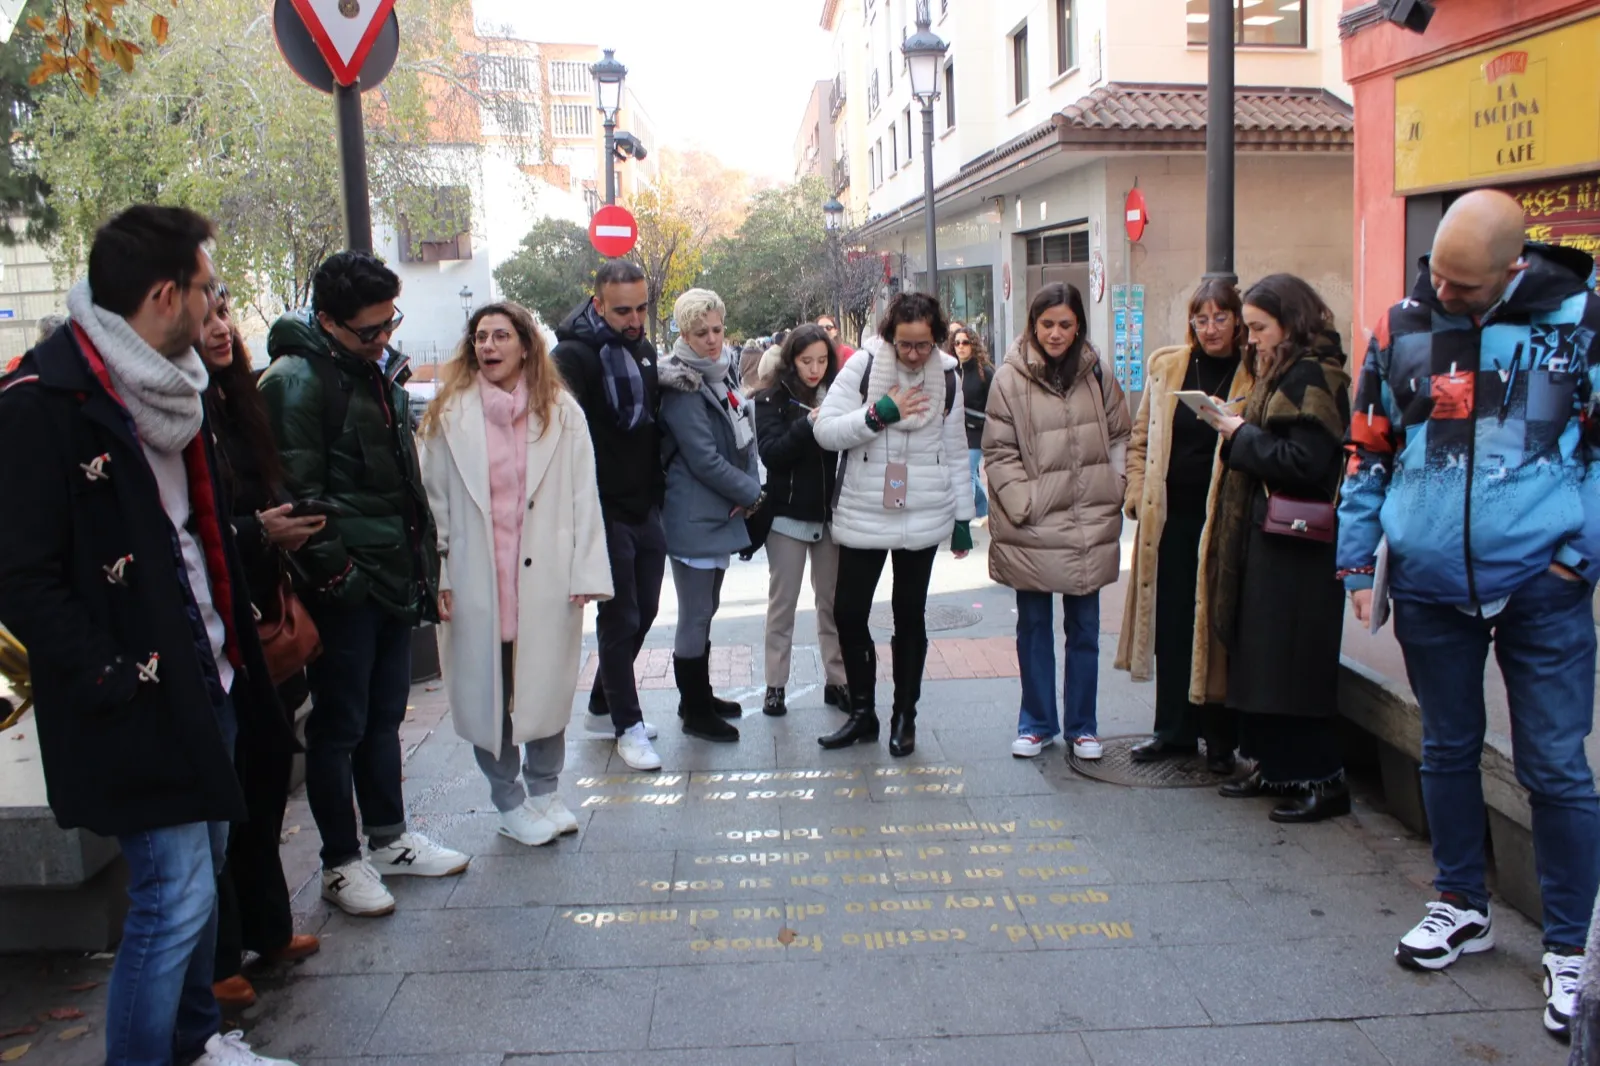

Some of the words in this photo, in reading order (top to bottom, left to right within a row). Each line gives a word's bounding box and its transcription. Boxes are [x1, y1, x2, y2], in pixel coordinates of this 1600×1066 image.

[1497, 82, 1518, 103] LA
[1474, 97, 1540, 129] ESQUINA
[746, 788, 815, 802] Toros
[693, 851, 810, 866] dichoso
[790, 875, 829, 887] en
[840, 870, 953, 886] fiestas
[964, 867, 1004, 880] en
[739, 877, 773, 889] su
[943, 894, 997, 912] rey
[1002, 893, 1037, 912] al
[1048, 888, 1110, 906] que
[732, 903, 826, 920] alivia
[844, 898, 933, 914] moro
[689, 908, 719, 926] el
[689, 935, 824, 952] famoso
[841, 928, 967, 950] castillo
